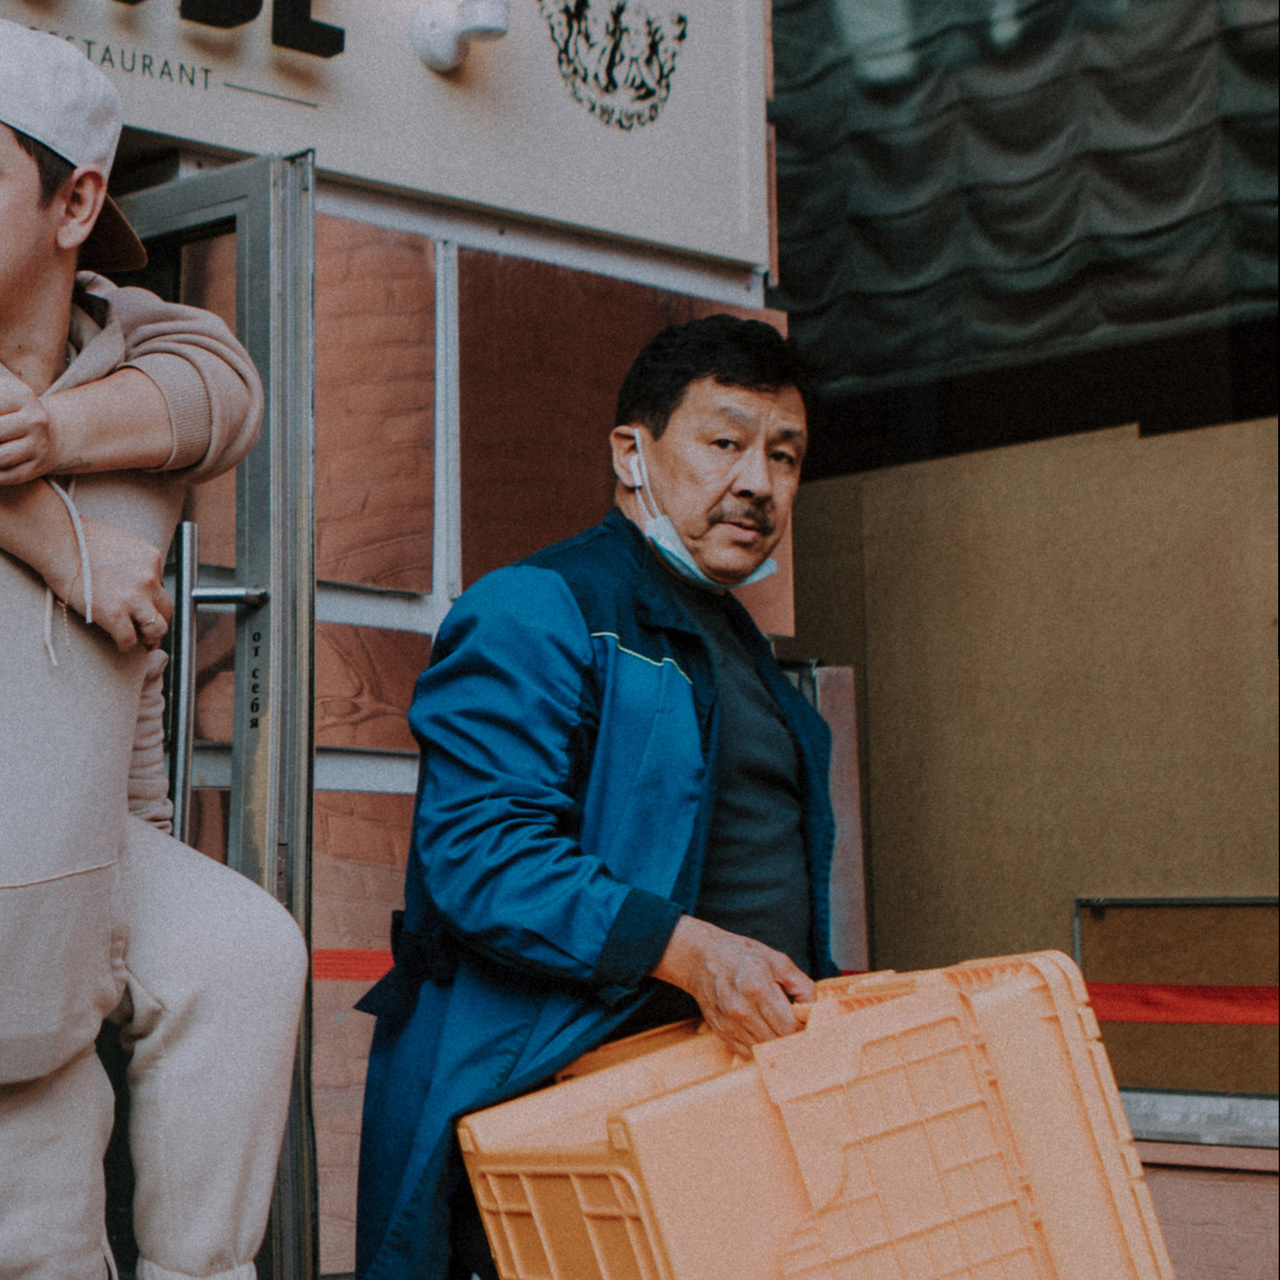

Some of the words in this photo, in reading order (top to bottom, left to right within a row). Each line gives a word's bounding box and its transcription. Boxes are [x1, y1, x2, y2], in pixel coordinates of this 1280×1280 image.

[29, 26, 213, 89] TAURANT
[251, 631, 261, 657] от
[249, 668, 260, 729] себя
